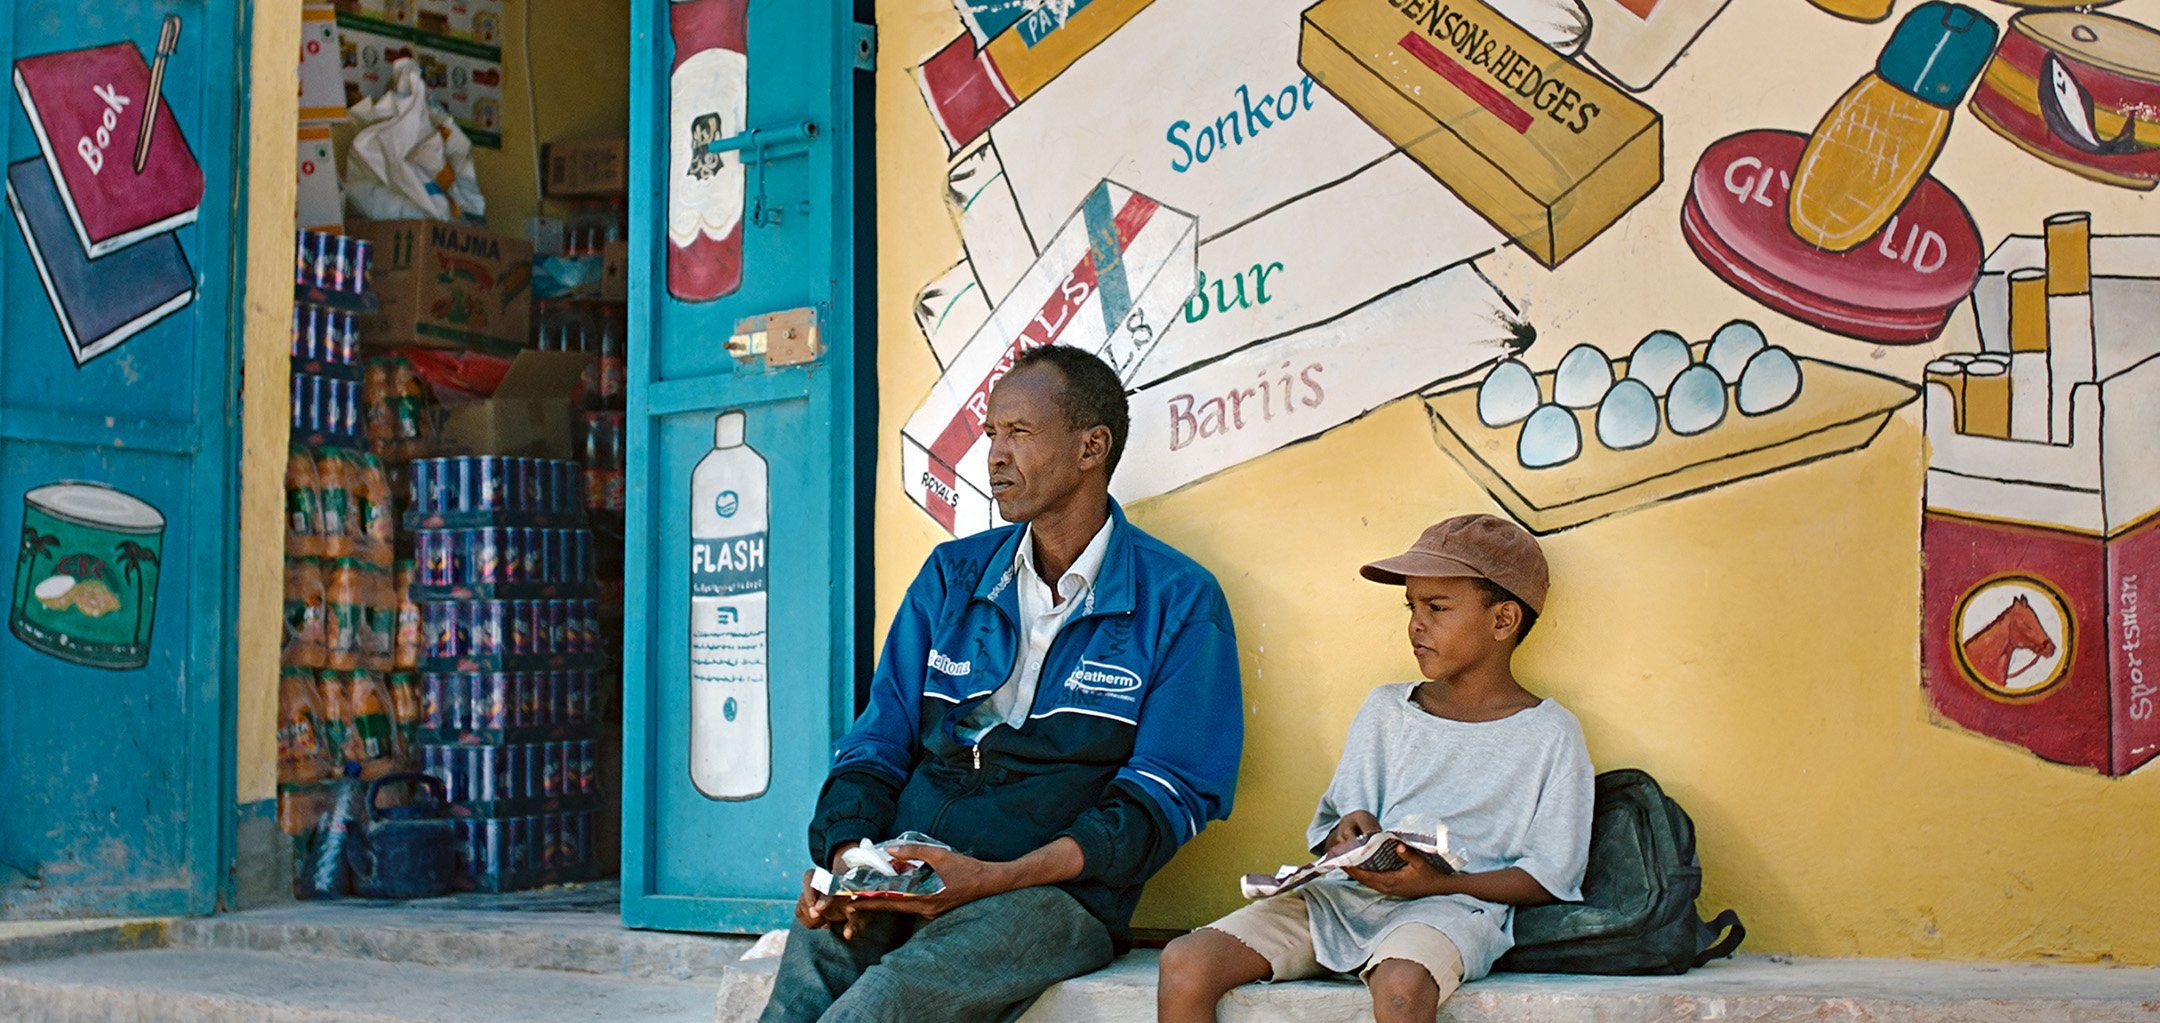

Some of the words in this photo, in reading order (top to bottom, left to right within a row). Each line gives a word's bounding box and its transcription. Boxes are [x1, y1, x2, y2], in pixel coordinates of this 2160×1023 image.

[77, 83, 131, 175] Book
[1166, 75, 1315, 173] Sonkor
[432, 225, 501, 260] NAJMA
[1167, 360, 1325, 451] Bariis
[921, 472, 960, 508] ROYALS
[692, 538, 764, 574] FLASH
[2121, 574, 2158, 721] Sportsman
